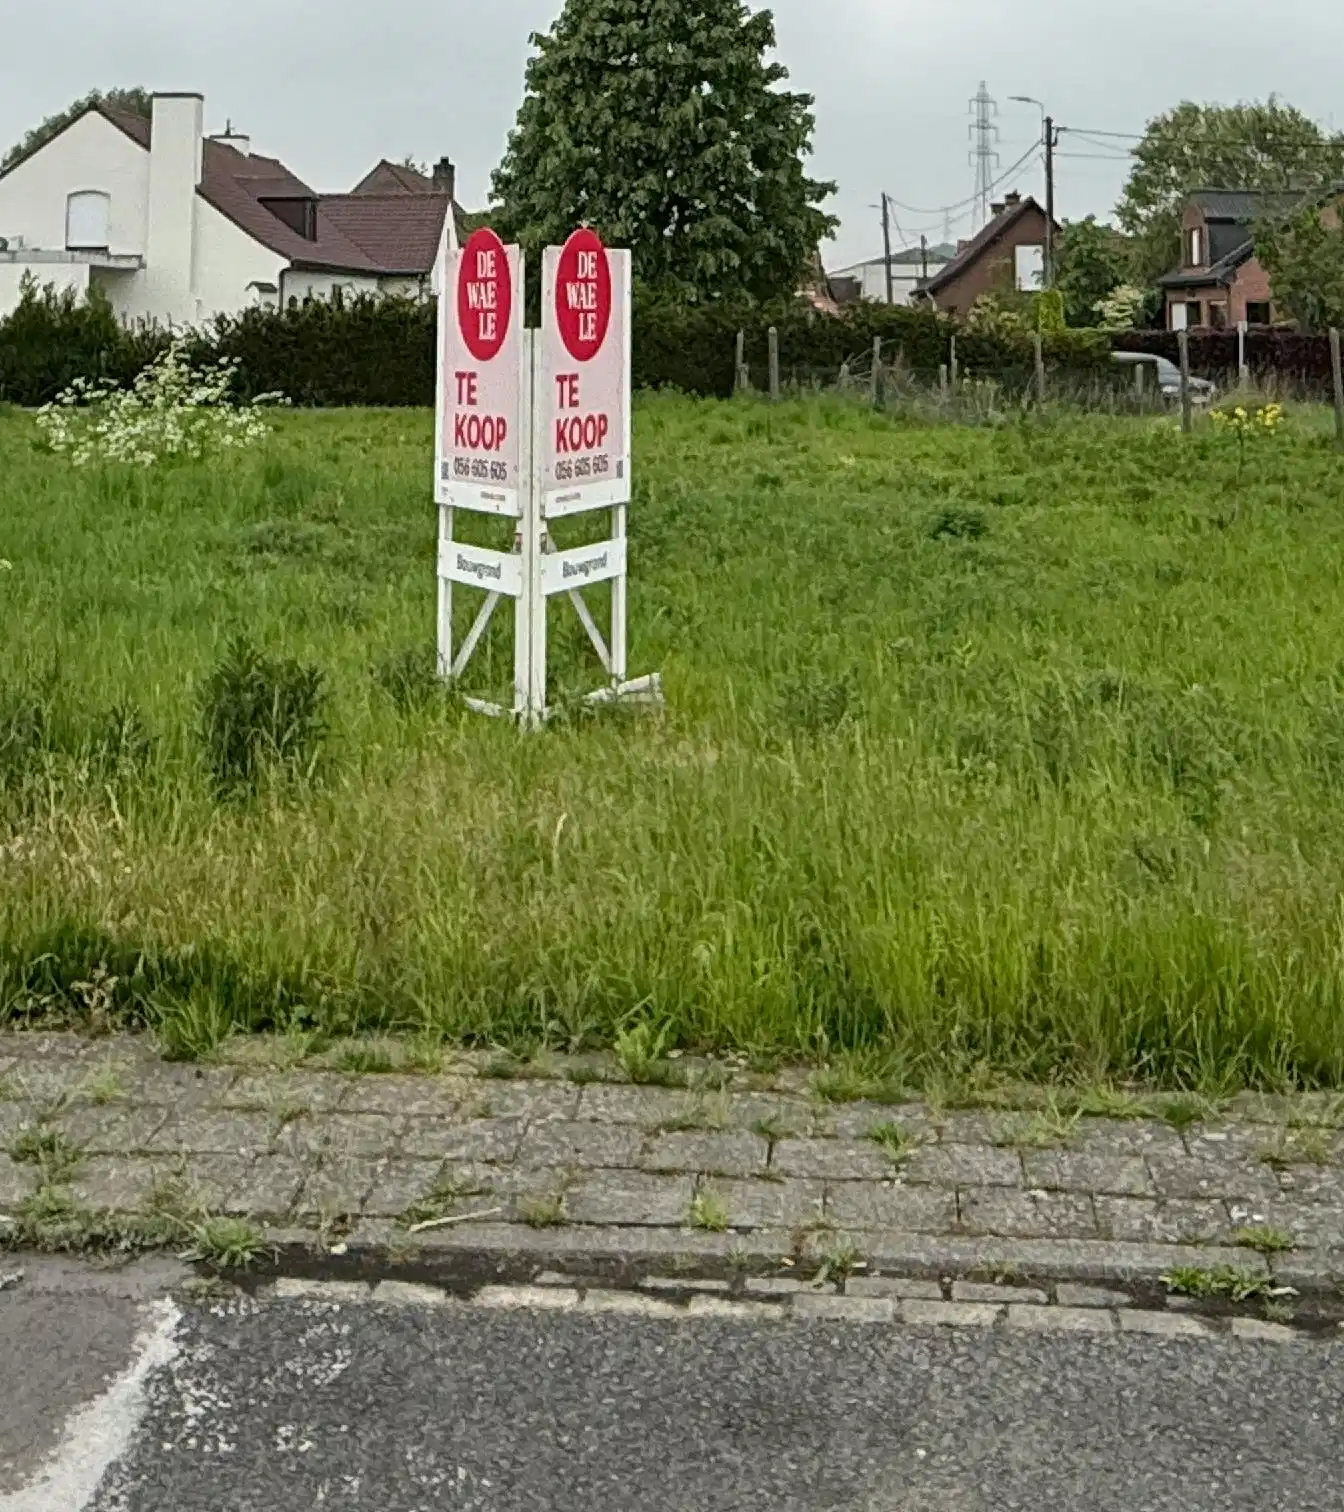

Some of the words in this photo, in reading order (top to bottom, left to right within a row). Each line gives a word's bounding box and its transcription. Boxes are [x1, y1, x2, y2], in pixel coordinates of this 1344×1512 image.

[477, 250, 496, 278] DE
[577, 251, 598, 279] DE
[467, 281, 497, 309] WAE
[566, 281, 598, 309] WAE
[478, 312, 497, 340] LE
[578, 312, 598, 341] LE
[455, 371, 478, 406] TE
[555, 373, 580, 409] TE
[454, 412, 507, 452] KOOP
[555, 413, 609, 454] KOOP
